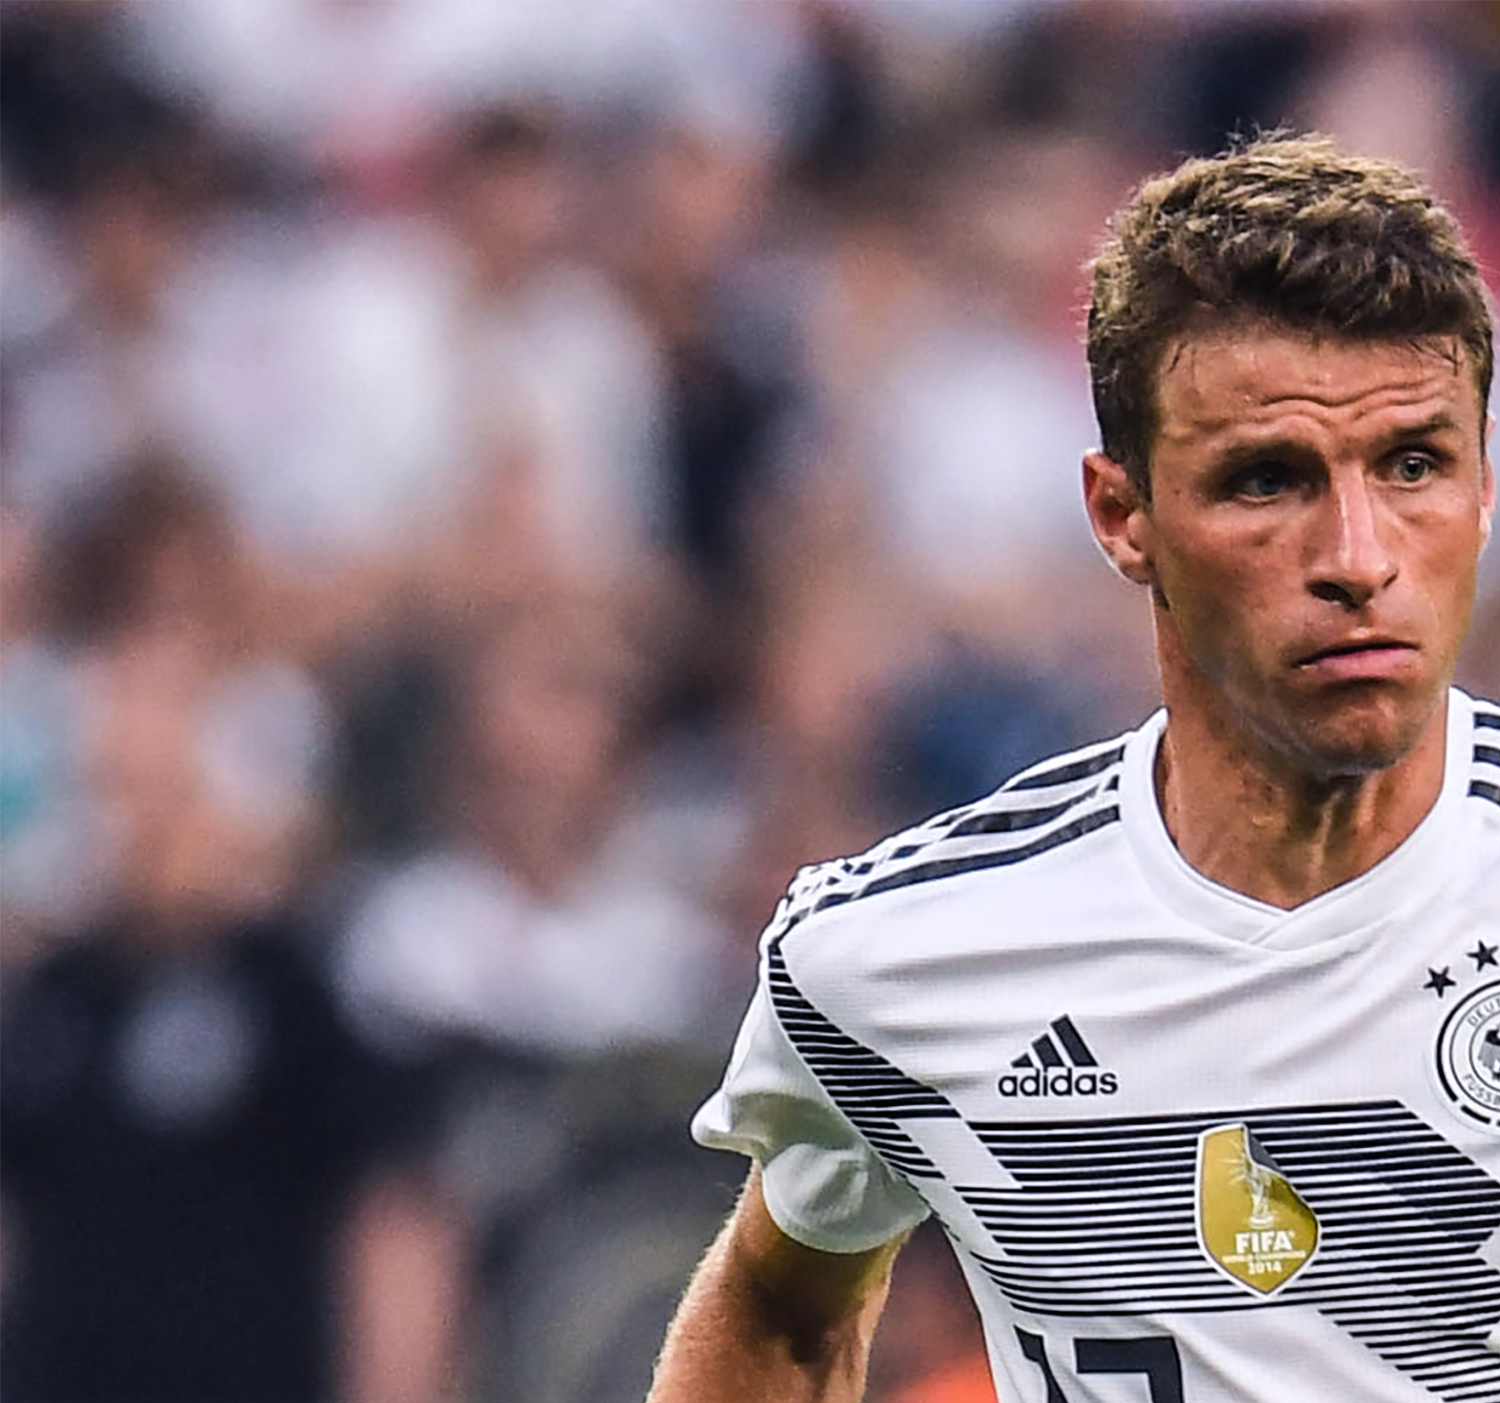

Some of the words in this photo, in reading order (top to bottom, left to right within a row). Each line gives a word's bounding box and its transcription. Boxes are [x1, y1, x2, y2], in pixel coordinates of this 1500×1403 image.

[998, 1066, 1118, 1097] adidas
[1235, 1231, 1294, 1254] FIFA
[1248, 1261, 1283, 1276] 2014
